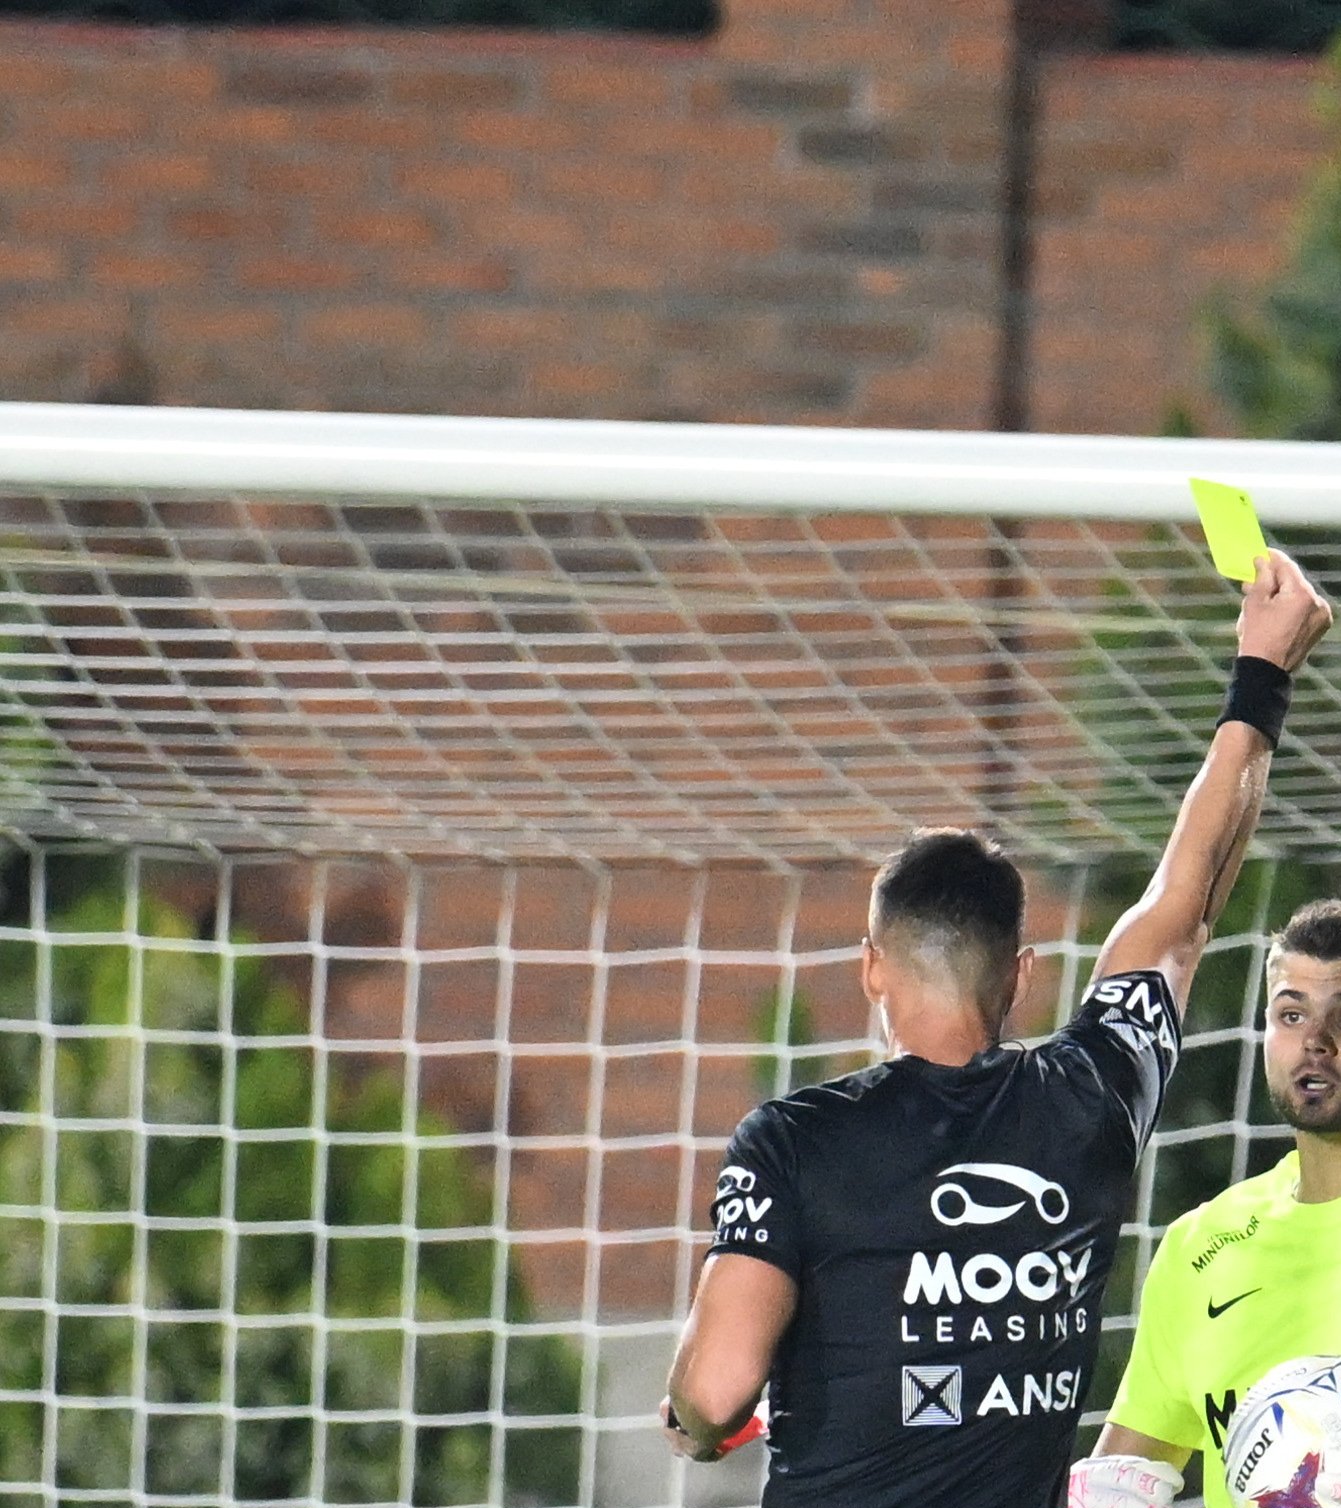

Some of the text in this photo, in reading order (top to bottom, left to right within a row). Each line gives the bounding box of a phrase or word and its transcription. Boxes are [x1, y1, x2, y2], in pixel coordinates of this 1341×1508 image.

[1191, 1215, 1260, 1274] MINUNILOR
[903, 1247, 1092, 1305] MOOV
[901, 1307, 1087, 1342] LEASING
[976, 1365, 1082, 1418] ANSI
